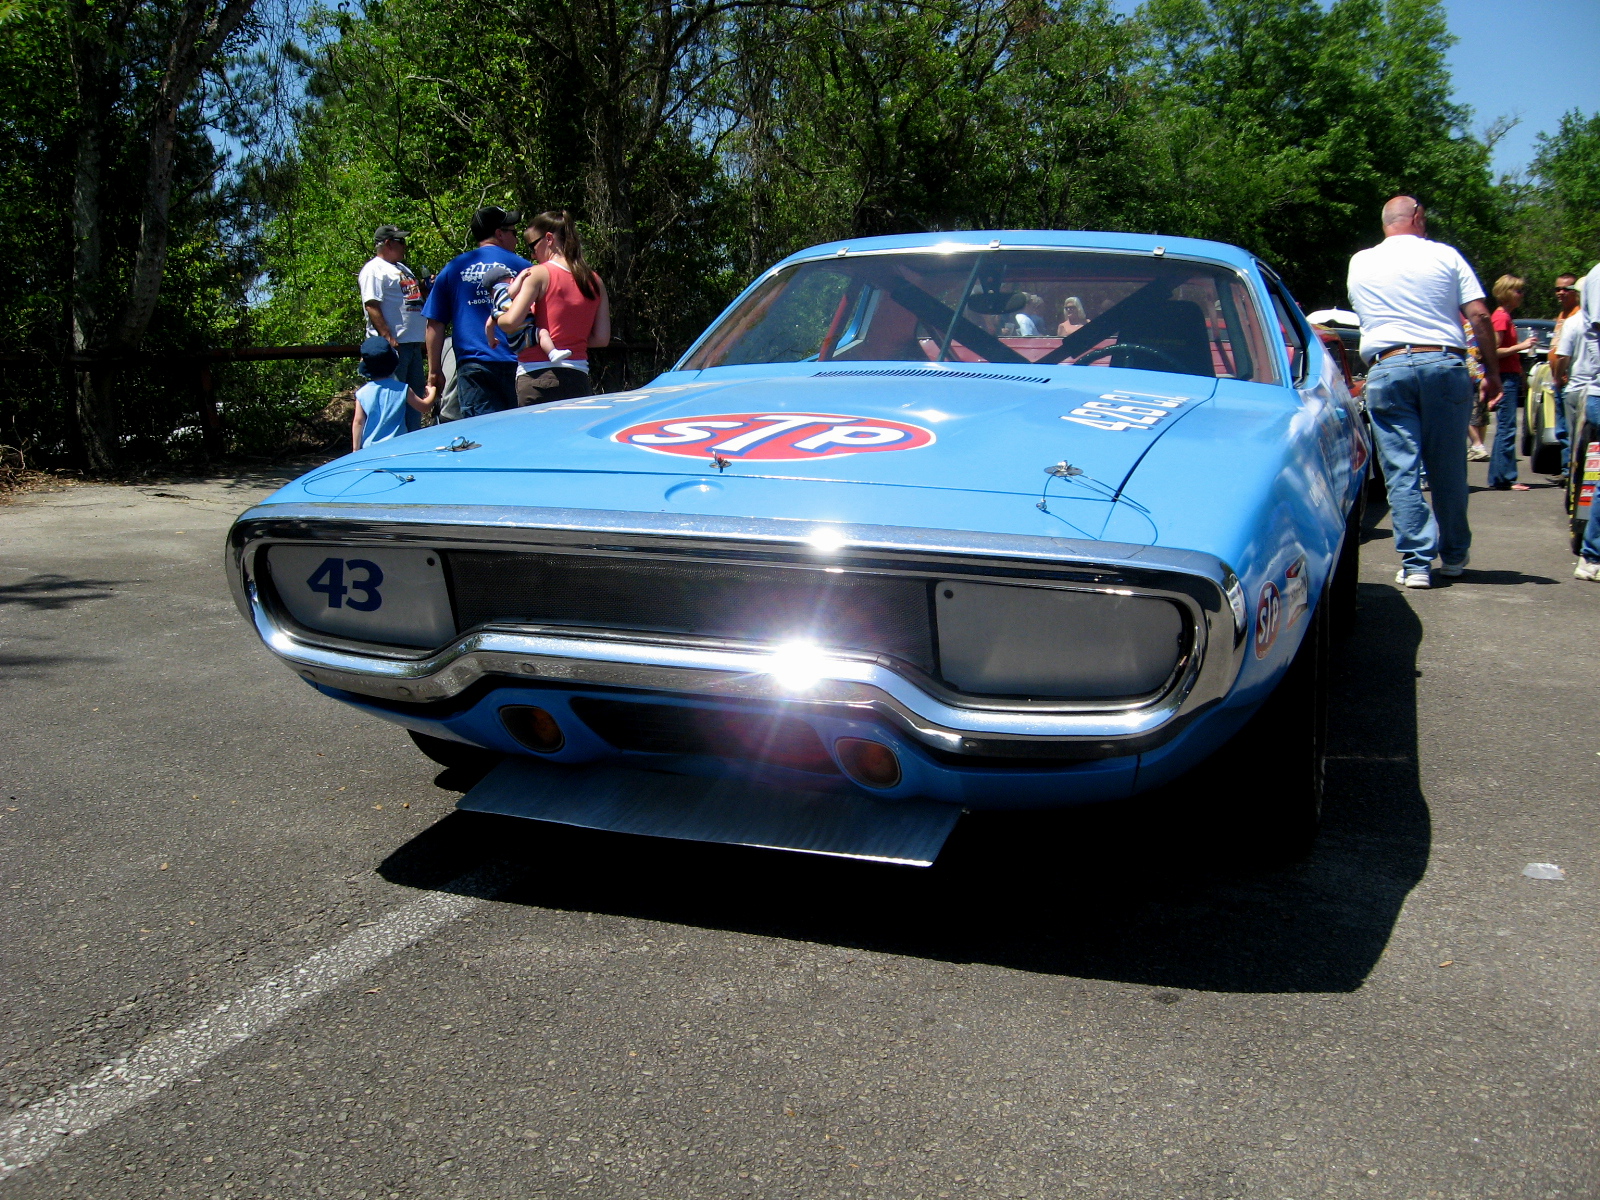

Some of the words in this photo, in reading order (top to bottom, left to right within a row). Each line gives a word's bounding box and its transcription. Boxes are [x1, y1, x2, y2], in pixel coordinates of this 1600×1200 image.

[630, 414, 911, 456] STP
[1059, 401, 1171, 431] 426
[306, 557, 384, 612] 43
[1257, 586, 1279, 645] STP
